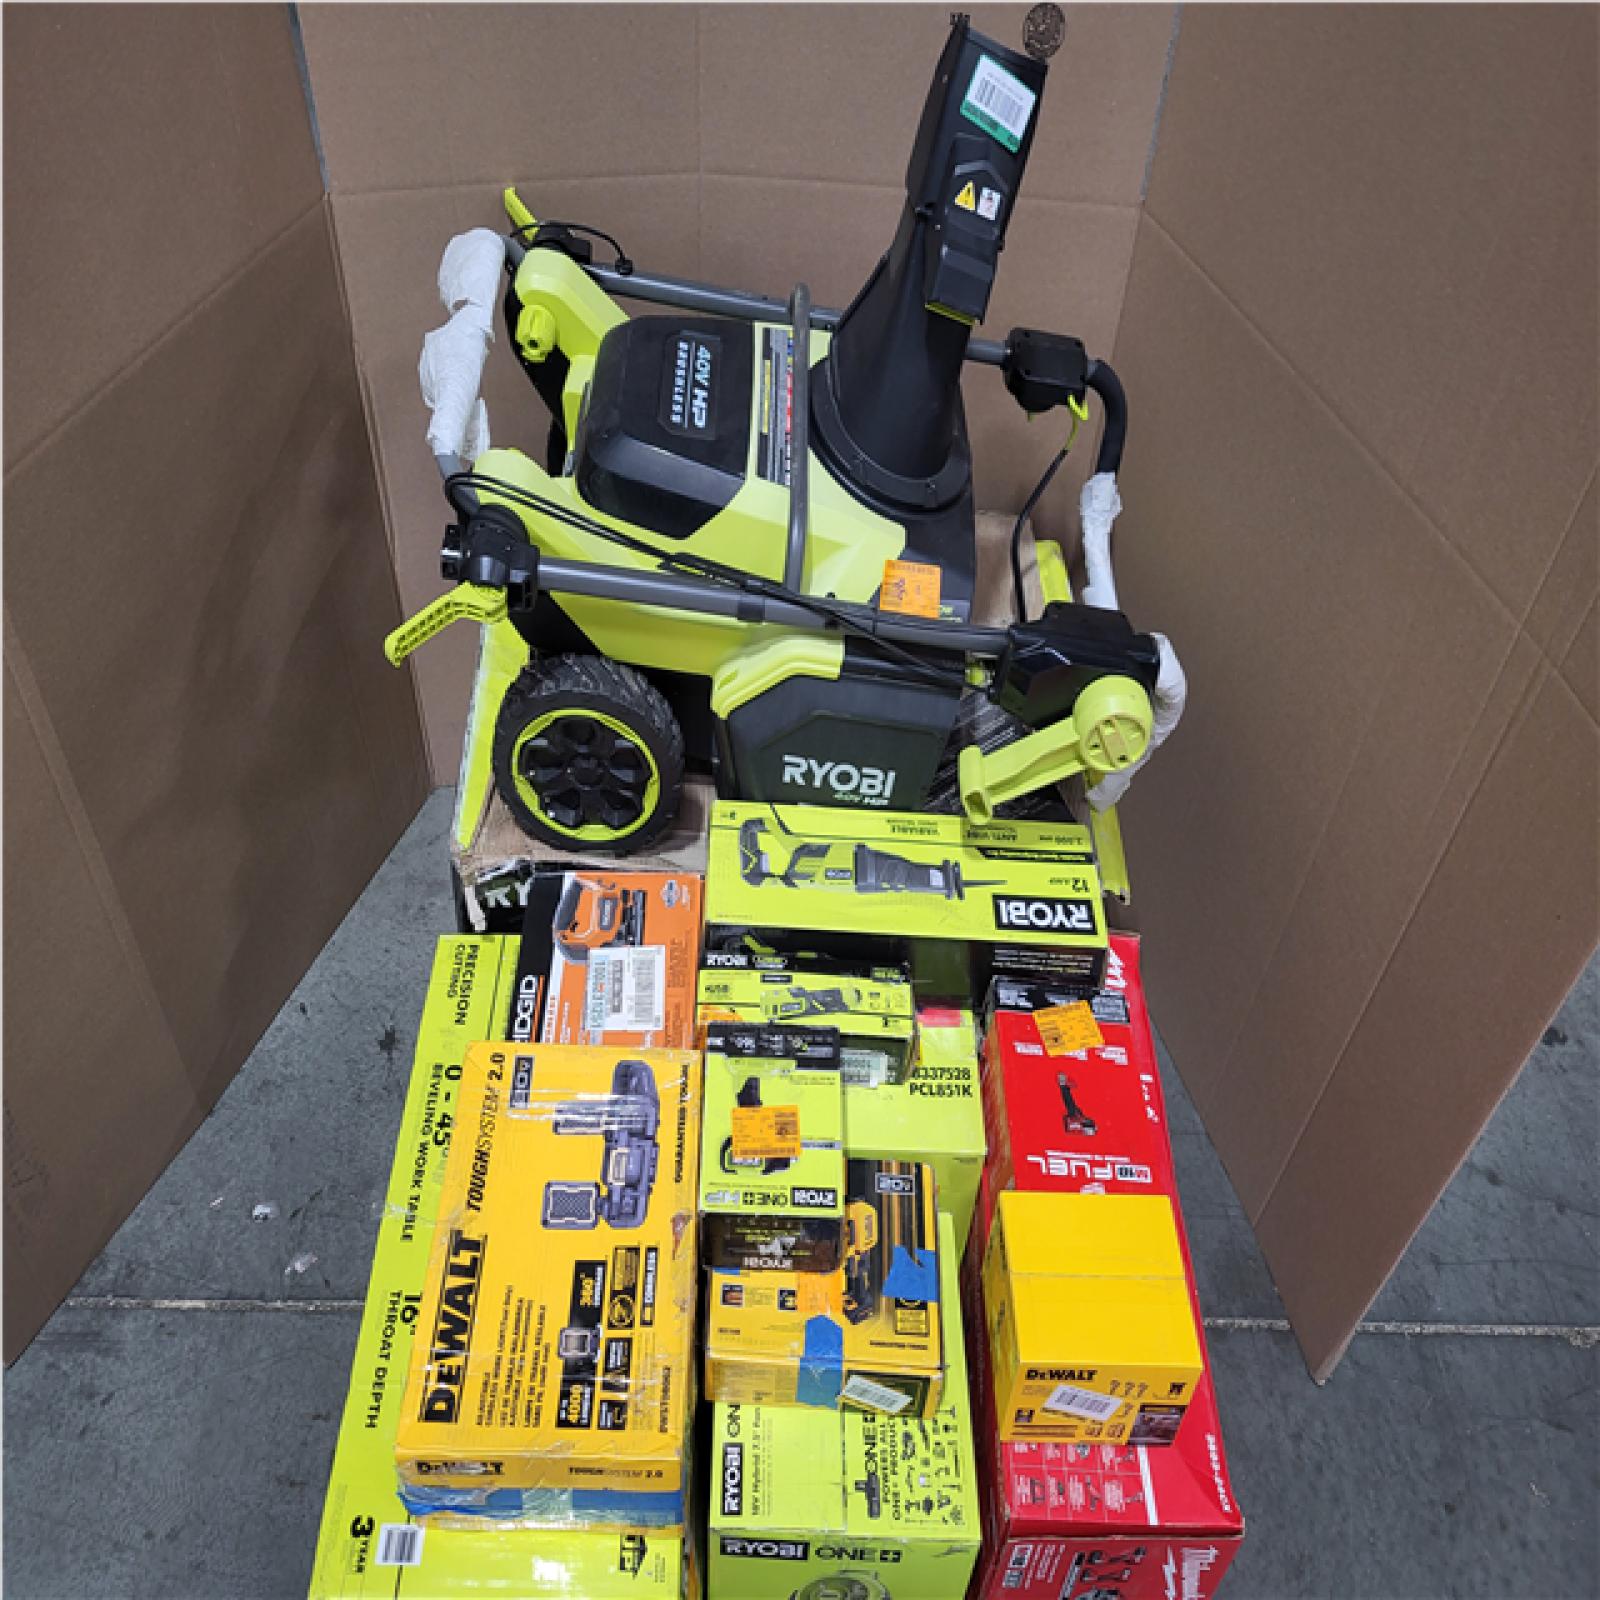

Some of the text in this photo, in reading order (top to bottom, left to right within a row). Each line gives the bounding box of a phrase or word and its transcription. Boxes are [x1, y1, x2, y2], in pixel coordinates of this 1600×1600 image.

[782, 754, 896, 798] RYOBI
[1072, 877, 1090, 893] 12
[999, 900, 1092, 929] RYOBI
[447, 942, 467, 999] CUTTING
[455, 944, 480, 1026] PRECISION
[512, 975, 538, 1043] IDGID
[445, 1063, 462, 1081] 0
[400, 1062, 445, 1243] BEVELING WORK TABLE
[466, 1052, 506, 1212] TOUGHSYSTEM 2.0
[1027, 1155, 1112, 1181] FUEL
[794, 1189, 837, 1207] RYOBI
[364, 1289, 403, 1429] THROAT DEPTH
[567, 1384, 583, 1424] 4000
[724, 1405, 742, 1514] RYOBI ON
[887, 1417, 898, 1476] PRODUCT
[350, 1515, 376, 1575] 3 YEAR
[726, 1538, 807, 1559] RYOBI
